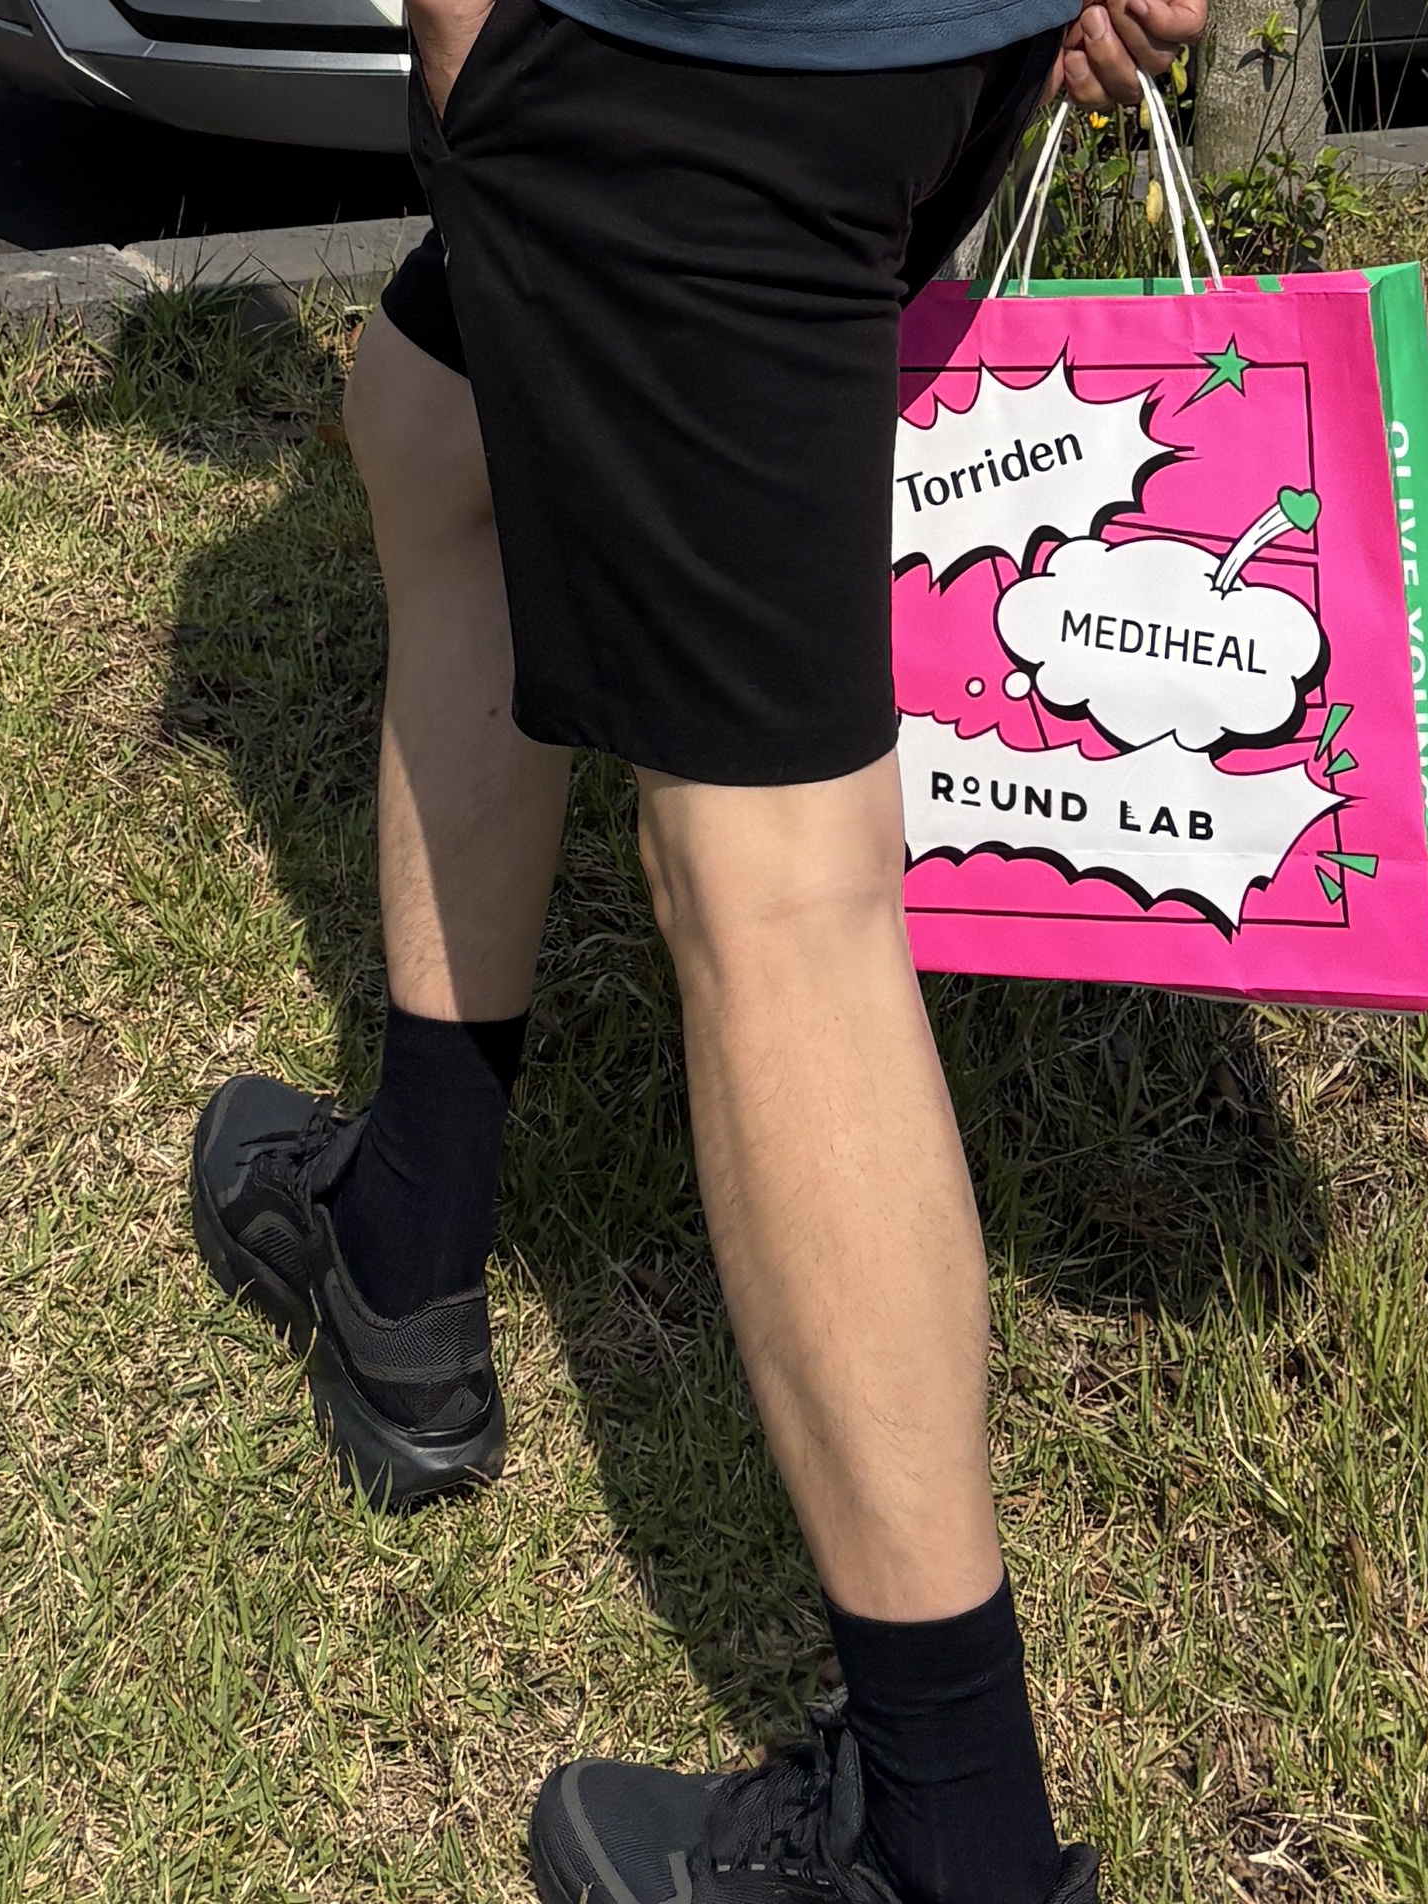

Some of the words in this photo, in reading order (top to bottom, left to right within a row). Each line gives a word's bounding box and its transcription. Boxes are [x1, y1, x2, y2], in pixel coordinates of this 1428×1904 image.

[895, 432, 1083, 512] Torriden
[1061, 609, 1267, 674] MEDIHEAL
[931, 770, 1088, 822] ROUND
[1120, 800, 1214, 841] LAB
